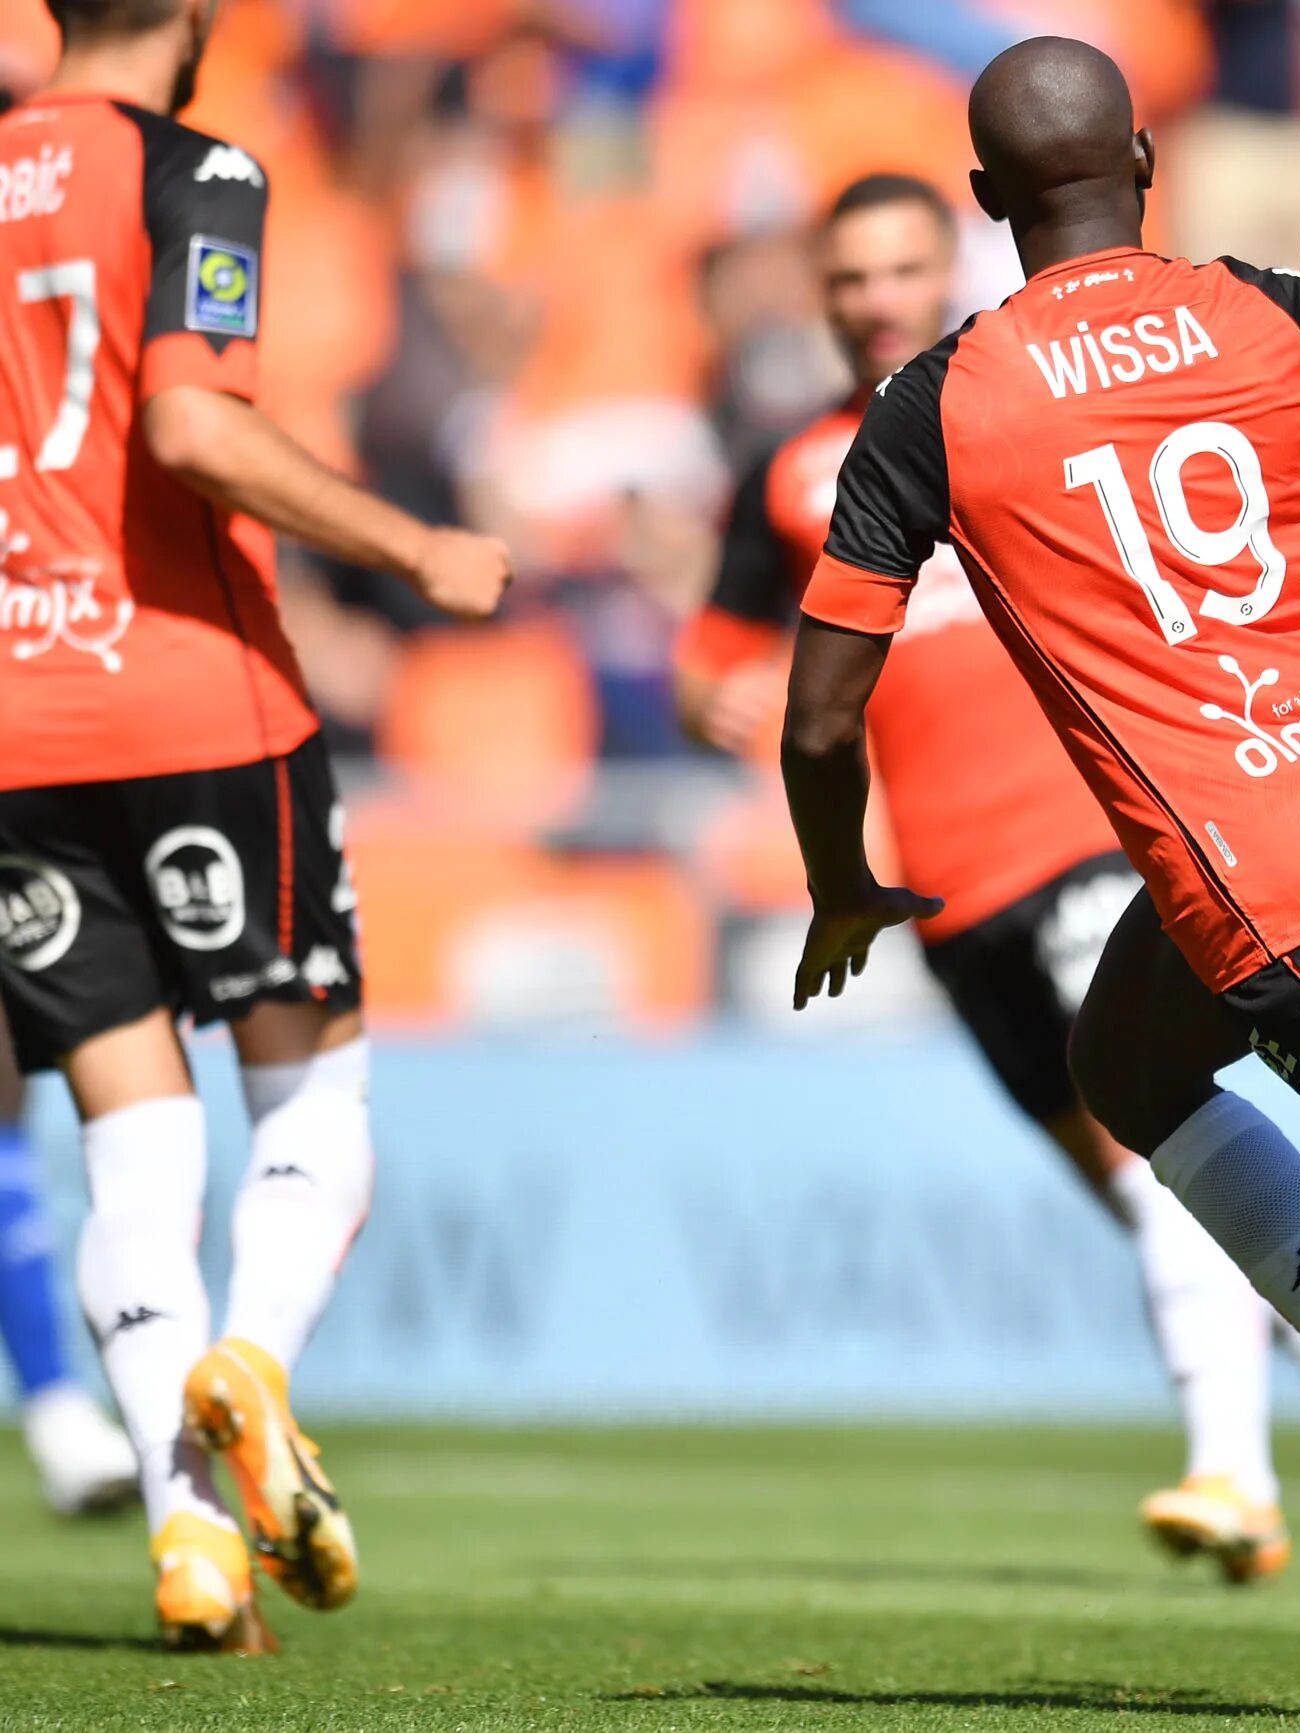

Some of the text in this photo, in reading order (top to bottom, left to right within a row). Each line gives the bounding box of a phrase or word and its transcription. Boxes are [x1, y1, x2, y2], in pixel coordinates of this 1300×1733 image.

[0, 259, 99, 479] 7
[1063, 421, 1287, 647] 19
[1271, 699, 1294, 719] for
